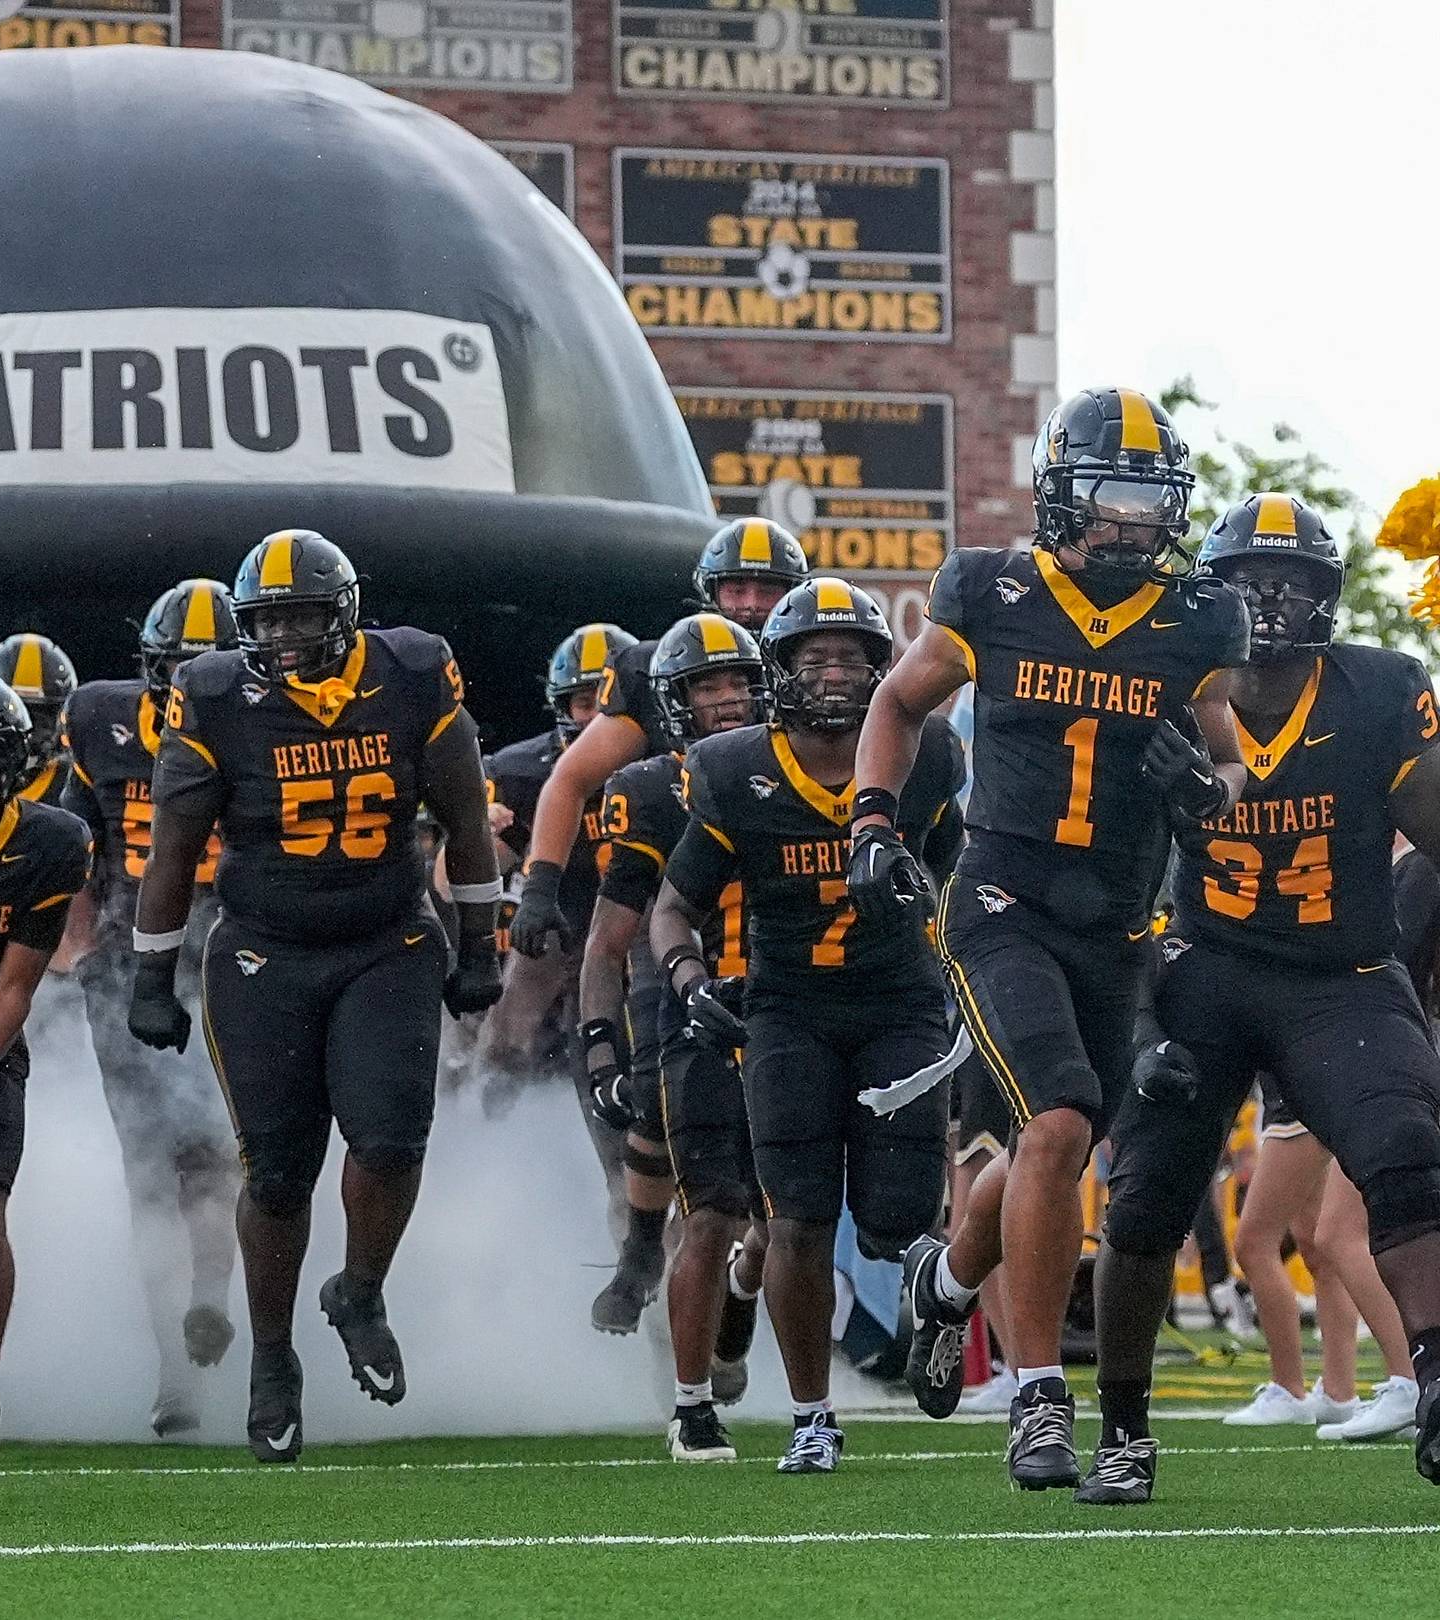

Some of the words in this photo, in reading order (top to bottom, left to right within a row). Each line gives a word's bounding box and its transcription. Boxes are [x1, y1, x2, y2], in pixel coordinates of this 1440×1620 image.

[623, 48, 940, 98] CHAMPIONS
[709, 215, 859, 250] STATE
[628, 283, 943, 333] CHAMPIONS
[713, 451, 862, 488] STATE
[1252, 536, 1298, 548] Riddell
[816, 612, 857, 623] Riddell
[165, 685, 187, 731] 6
[1015, 660, 1163, 718] HERITAGE
[273, 732, 392, 780] HERITAGE
[1054, 717, 1100, 848] 1
[279, 771, 397, 860] 56
[1201, 794, 1336, 834] RITAGE
[1202, 834, 1334, 924] 34
[811, 879, 859, 967] 7
